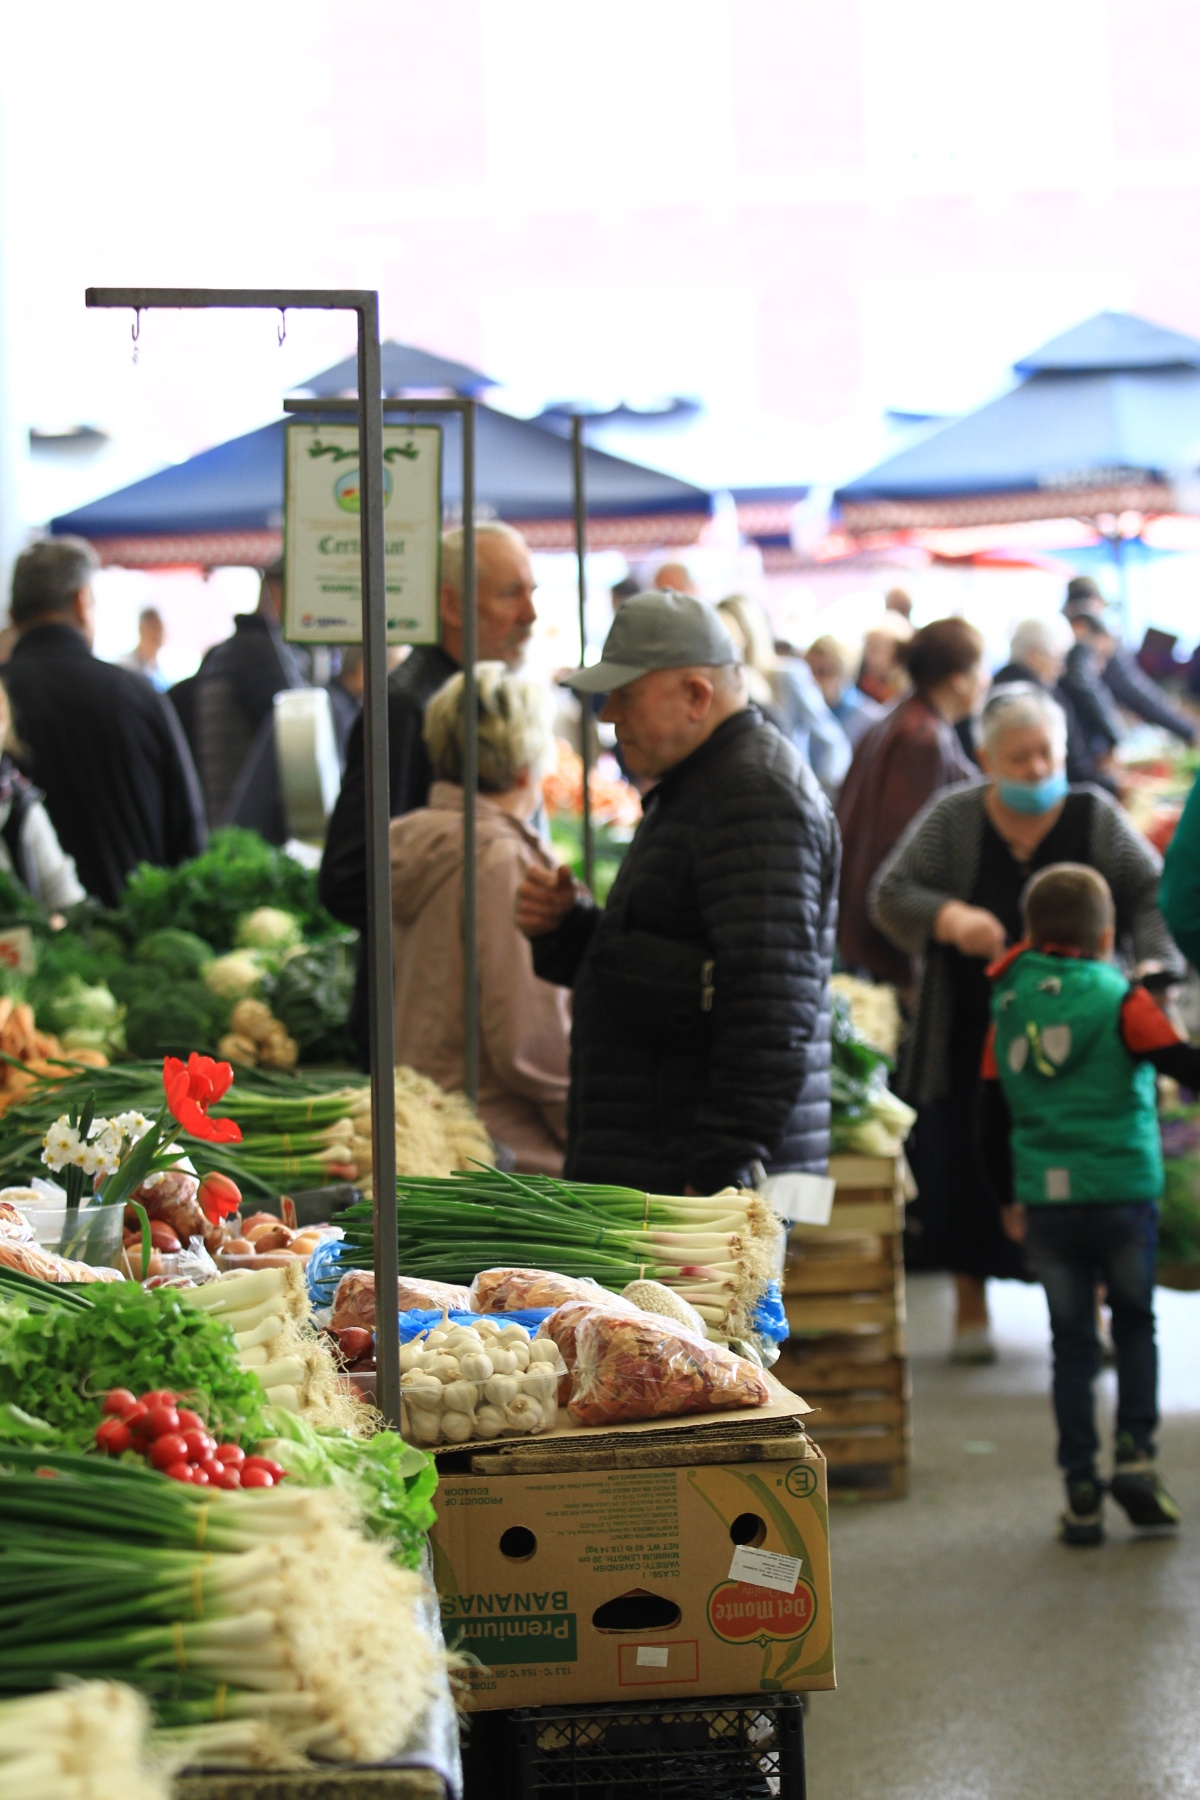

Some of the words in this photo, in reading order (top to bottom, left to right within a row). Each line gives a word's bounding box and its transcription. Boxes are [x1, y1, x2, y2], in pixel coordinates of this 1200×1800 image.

[444, 1488, 488, 1496] ECUADOR
[445, 1498, 457, 1506] OF
[459, 1497, 503, 1505] PRODUCT
[585, 1546, 598, 1554] kg)
[600, 1544, 623, 1553] (18.14
[604, 1554, 640, 1562] LENGTH:
[643, 1552, 679, 1560] MINIMUM
[593, 1563, 641, 1572] CAVENDISH
[643, 1561, 680, 1569] VARIETY:
[650, 1570, 680, 1578] CLASS:
[440, 1591, 568, 1615] BANANAS
[715, 1600, 774, 1621] Monte
[777, 1598, 806, 1619] Del
[460, 1619, 568, 1641] Premium
[555, 1667, 572, 1675] 13.3
[469, 1681, 496, 1690] STORE
